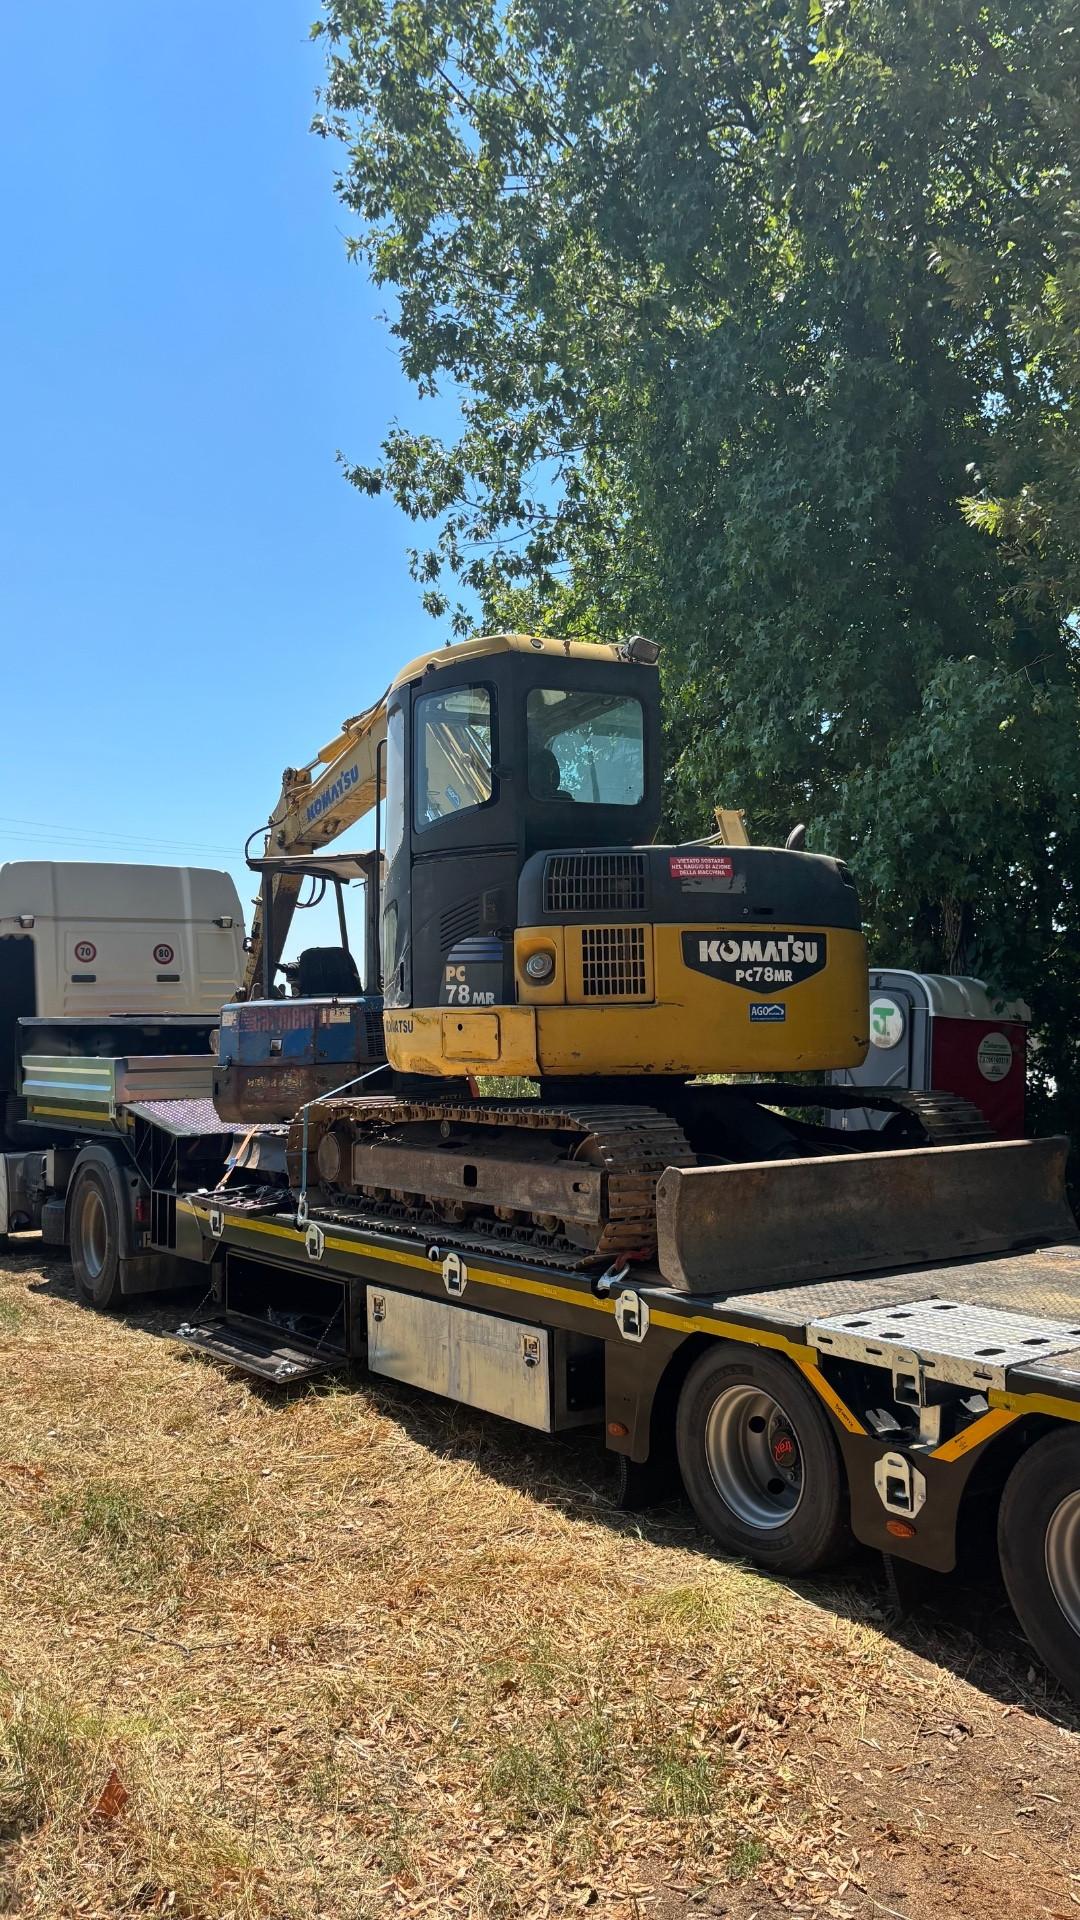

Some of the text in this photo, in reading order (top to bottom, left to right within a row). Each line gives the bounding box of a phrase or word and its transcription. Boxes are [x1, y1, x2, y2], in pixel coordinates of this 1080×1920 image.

[306, 764, 359, 822] KOMATSU
[80, 948, 91, 956] 70
[159, 949, 170, 958] 80
[699, 935, 818, 963] KOMATSU
[446, 966, 466, 982] PC
[735, 967, 793, 982] PC78MR
[446, 984, 495, 1005] 78 MR
[751, 1006, 769, 1016] AGO
